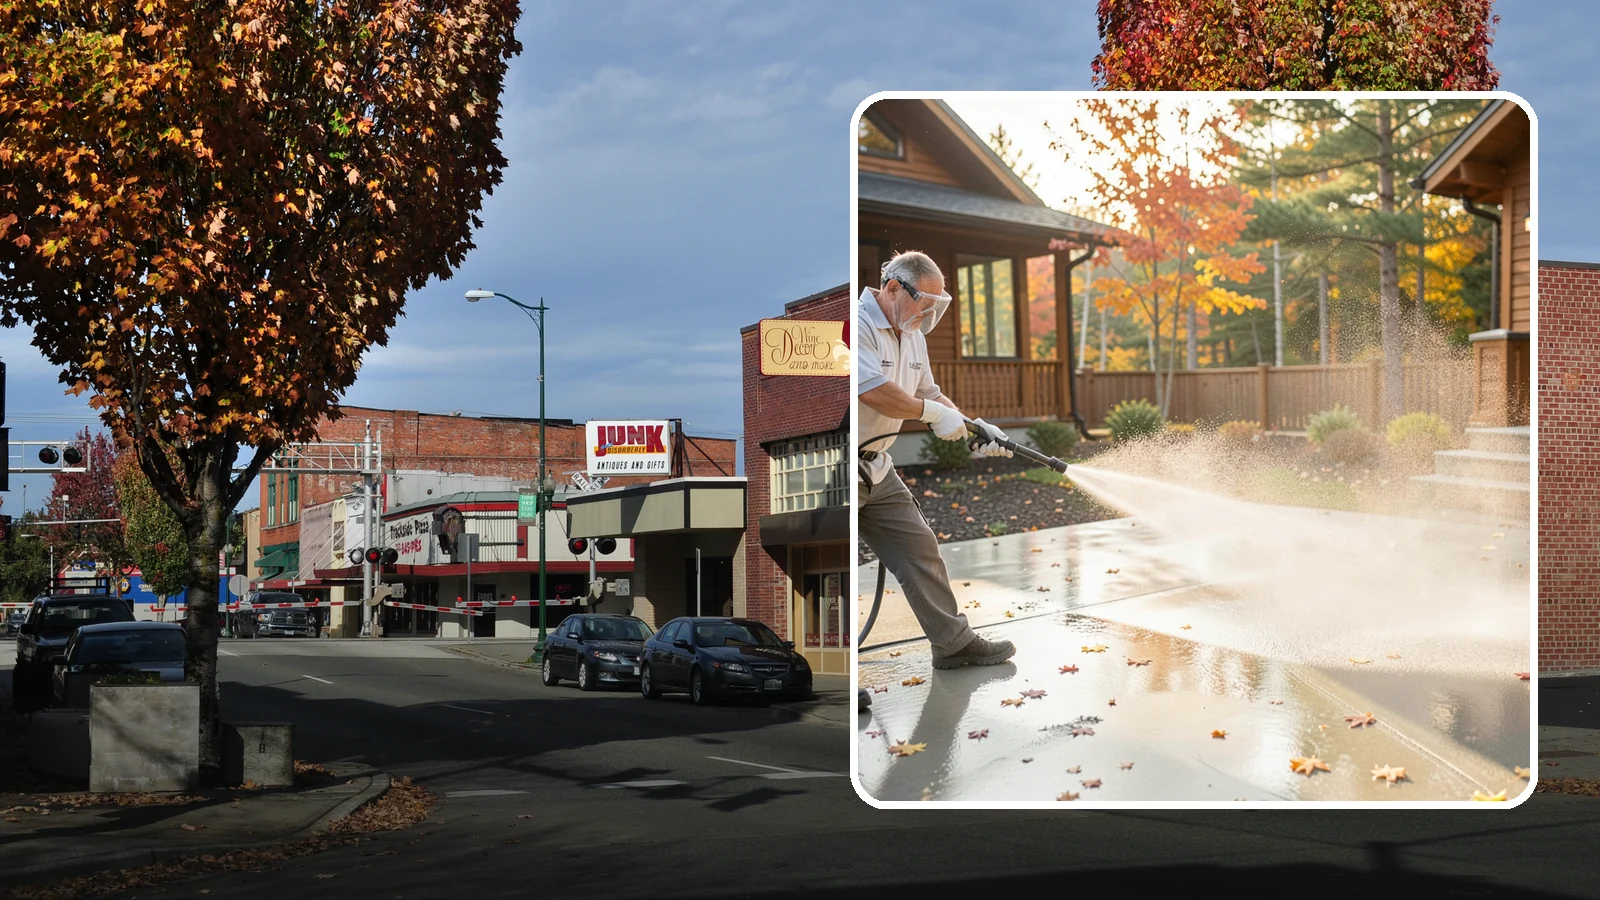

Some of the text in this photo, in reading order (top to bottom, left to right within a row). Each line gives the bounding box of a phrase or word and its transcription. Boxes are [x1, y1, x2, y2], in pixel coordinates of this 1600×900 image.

[791, 325, 823, 346] Wine
[765, 328, 831, 365] Decor
[595, 425, 664, 457] JUNK
[607, 446, 645, 455] DISORDERLY
[596, 460, 665, 470] ANTIQUES AND GIFTS
[390, 519, 429, 539] Trackside Pizza
